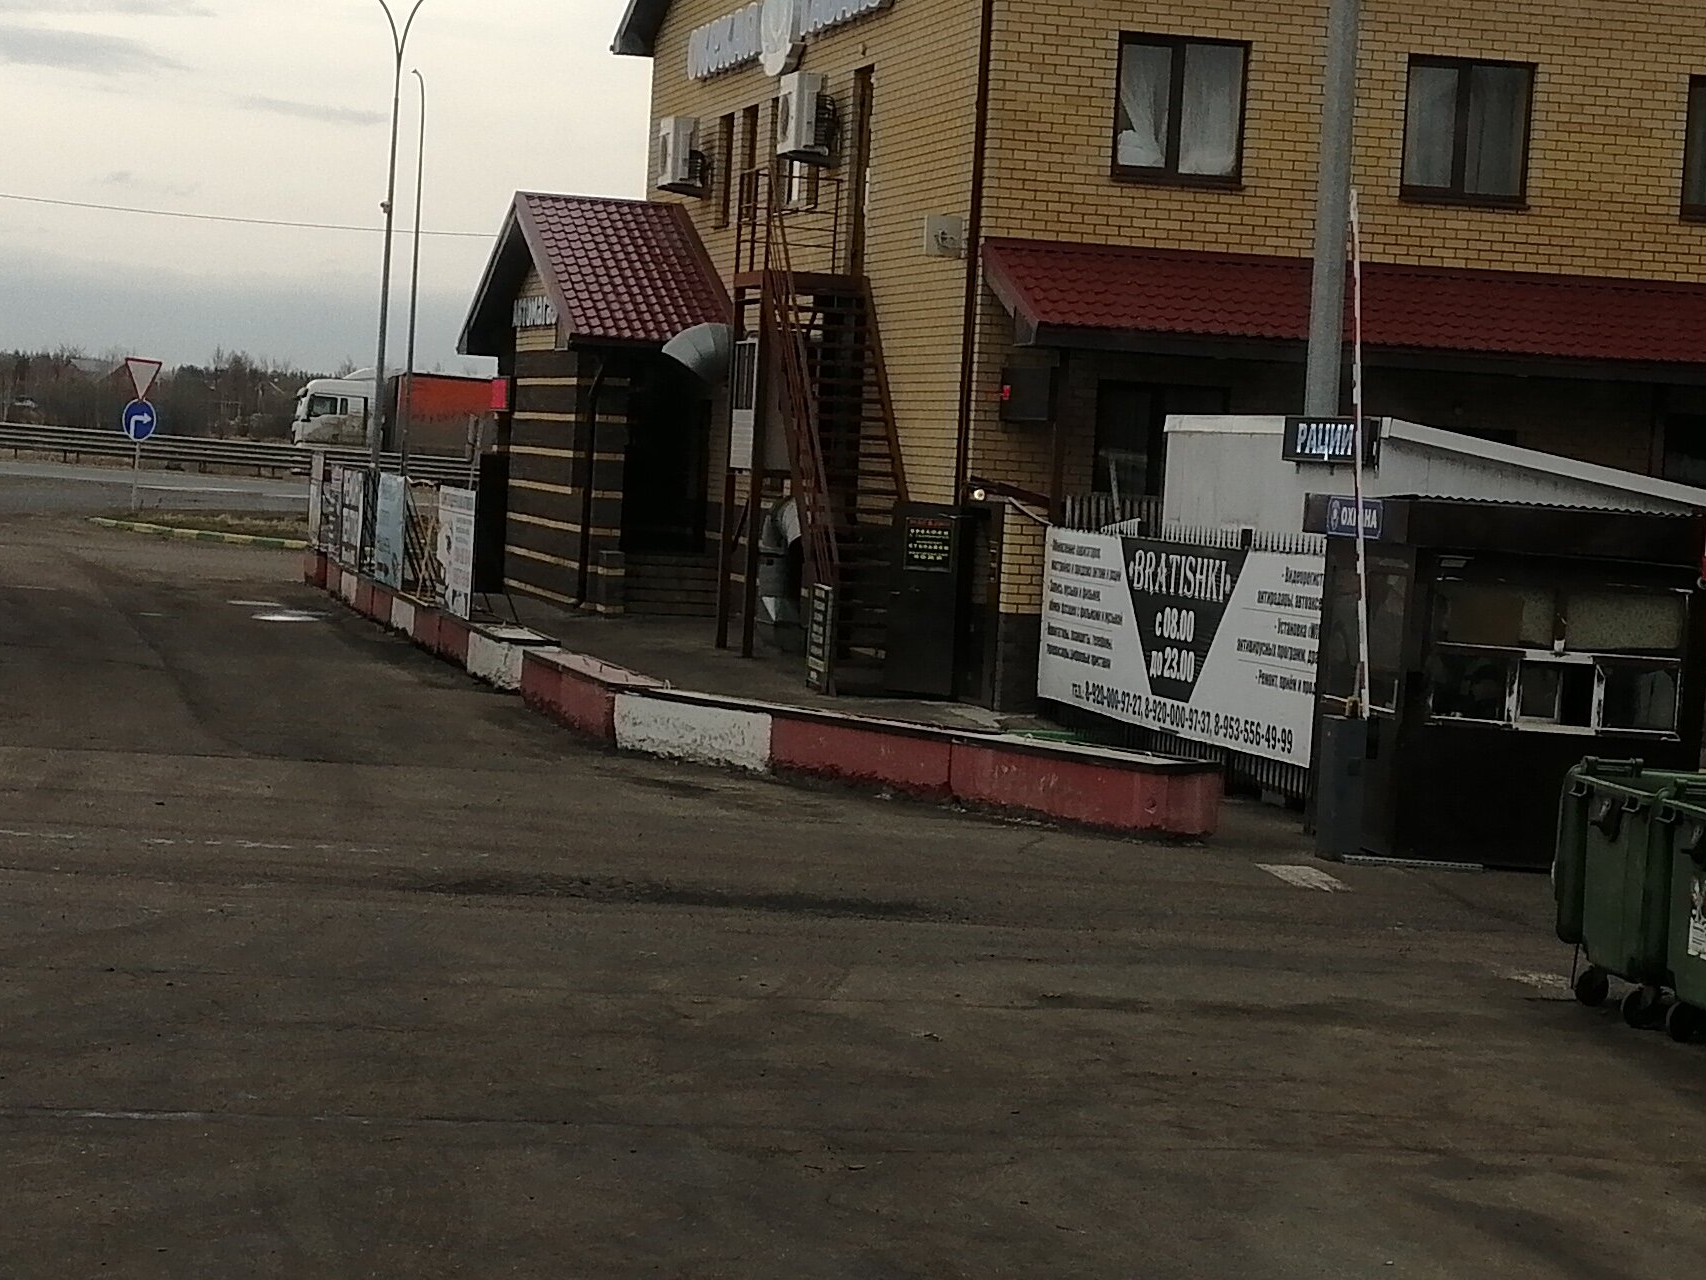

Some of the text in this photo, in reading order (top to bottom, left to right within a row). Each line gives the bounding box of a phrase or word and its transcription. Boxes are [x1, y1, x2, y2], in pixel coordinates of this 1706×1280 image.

[1296, 423, 1355, 461] РАЦИИ
[1155, 607, 1195, 642] с 08.00
[1150, 650, 1163, 679] до
[1163, 646, 1195, 683] 23.00
[1214, 712, 1293, 754] 8-953-556-49-99
